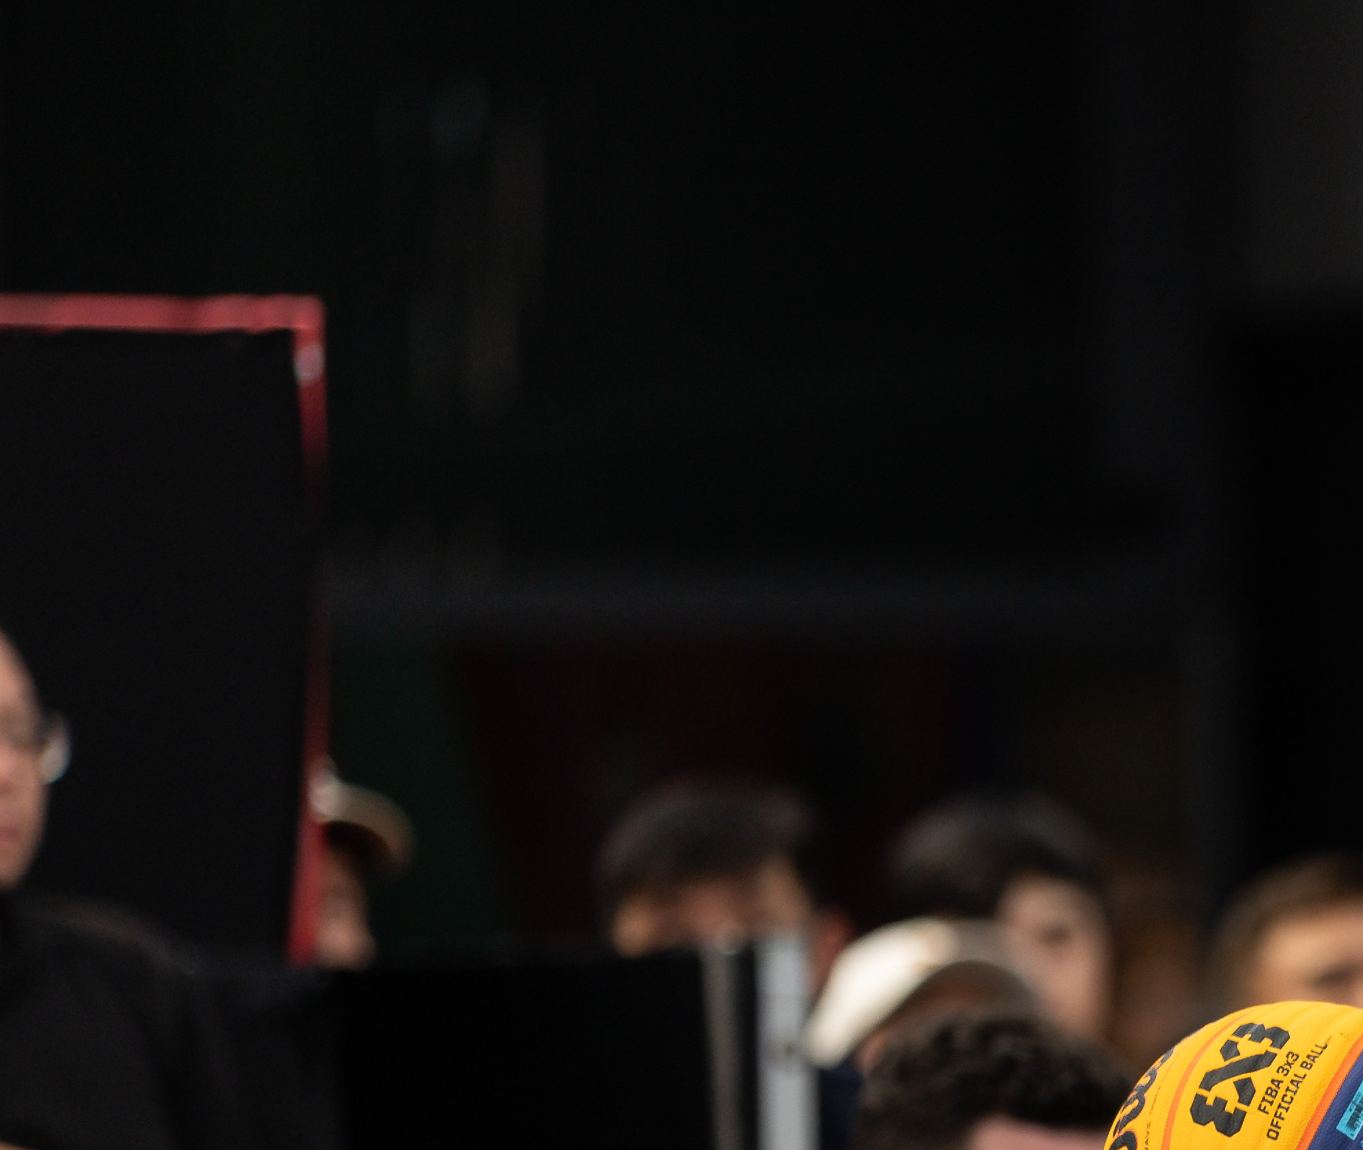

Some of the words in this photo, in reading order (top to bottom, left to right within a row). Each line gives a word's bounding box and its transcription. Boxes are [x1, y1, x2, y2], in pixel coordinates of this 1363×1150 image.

[1257, 1077, 1284, 1115] FIBA
[1266, 1072, 1307, 1142] OFFICIAL
[1299, 1042, 1329, 1070] BALL
